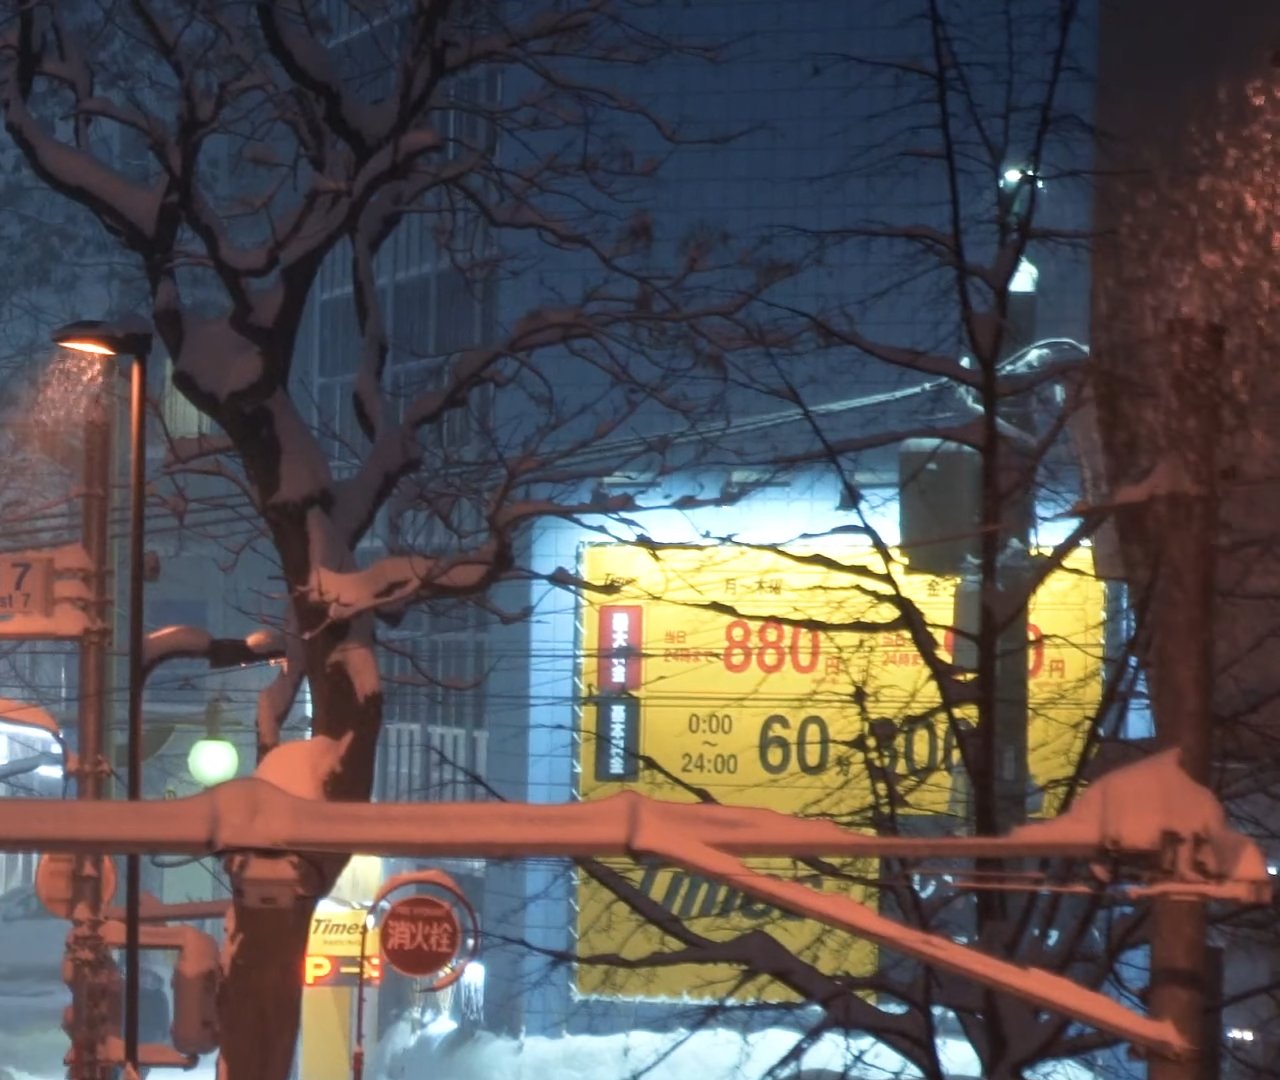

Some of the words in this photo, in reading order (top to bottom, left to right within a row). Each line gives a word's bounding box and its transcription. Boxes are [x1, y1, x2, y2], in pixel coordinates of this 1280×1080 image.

[21, 594, 31, 609] 7
[724, 618, 821, 674] 880
[688, 713, 733, 735] 0:00
[759, 714, 830, 776] 60
[681, 752, 738, 775] 24:00
[386, 920, 453, 952] 消火栓
